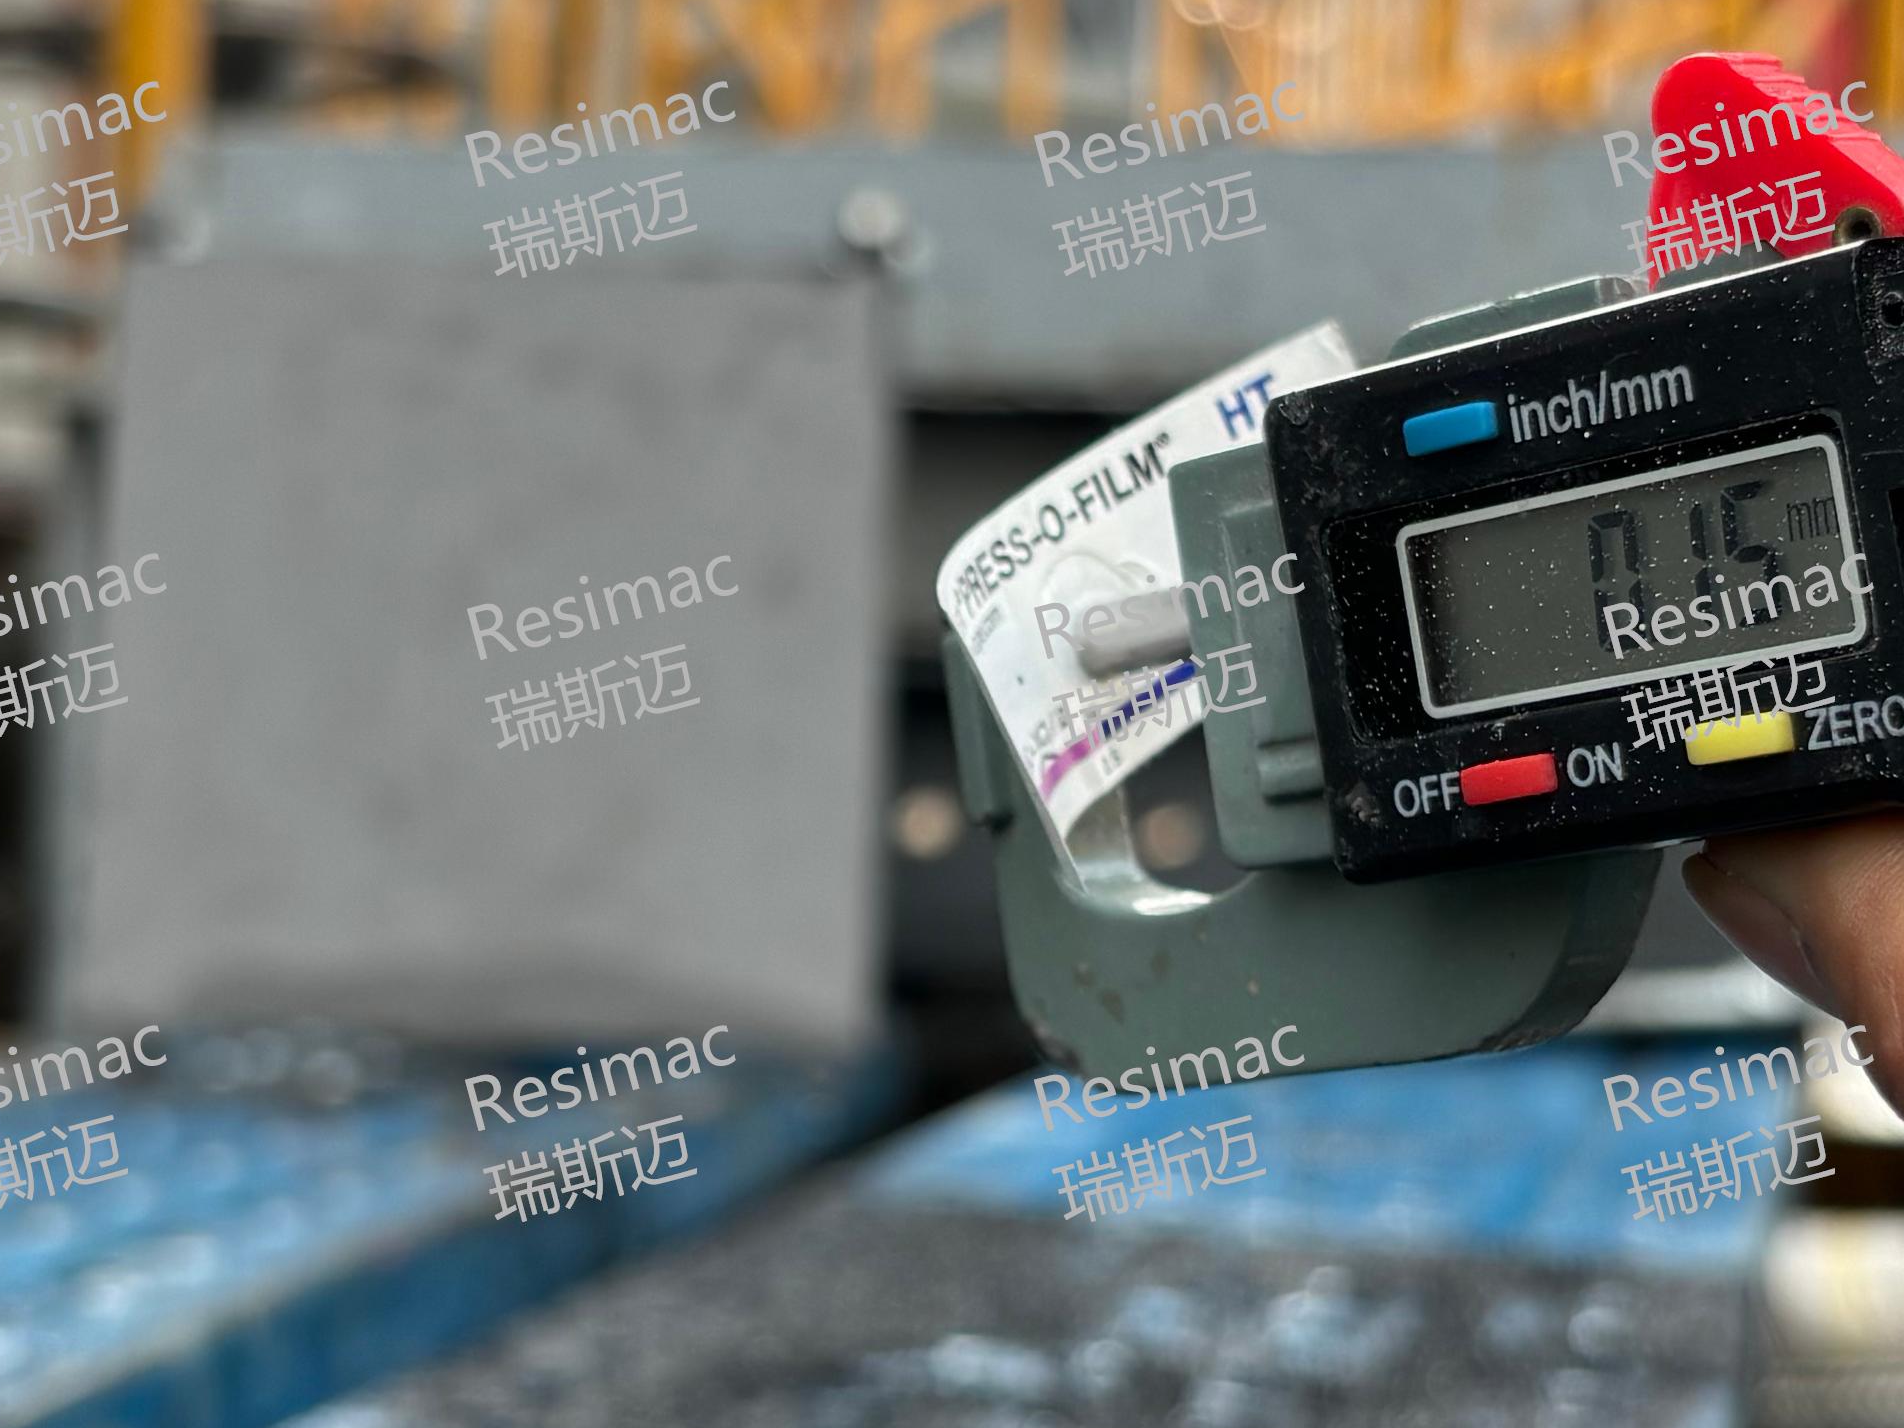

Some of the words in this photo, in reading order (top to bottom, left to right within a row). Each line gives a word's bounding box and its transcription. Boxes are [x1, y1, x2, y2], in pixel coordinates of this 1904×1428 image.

[1507, 364, 1695, 444] inch/mm
[1785, 495, 1841, 543] mm
[1566, 741, 1625, 789] ON
[1393, 771, 1461, 819] OFF
